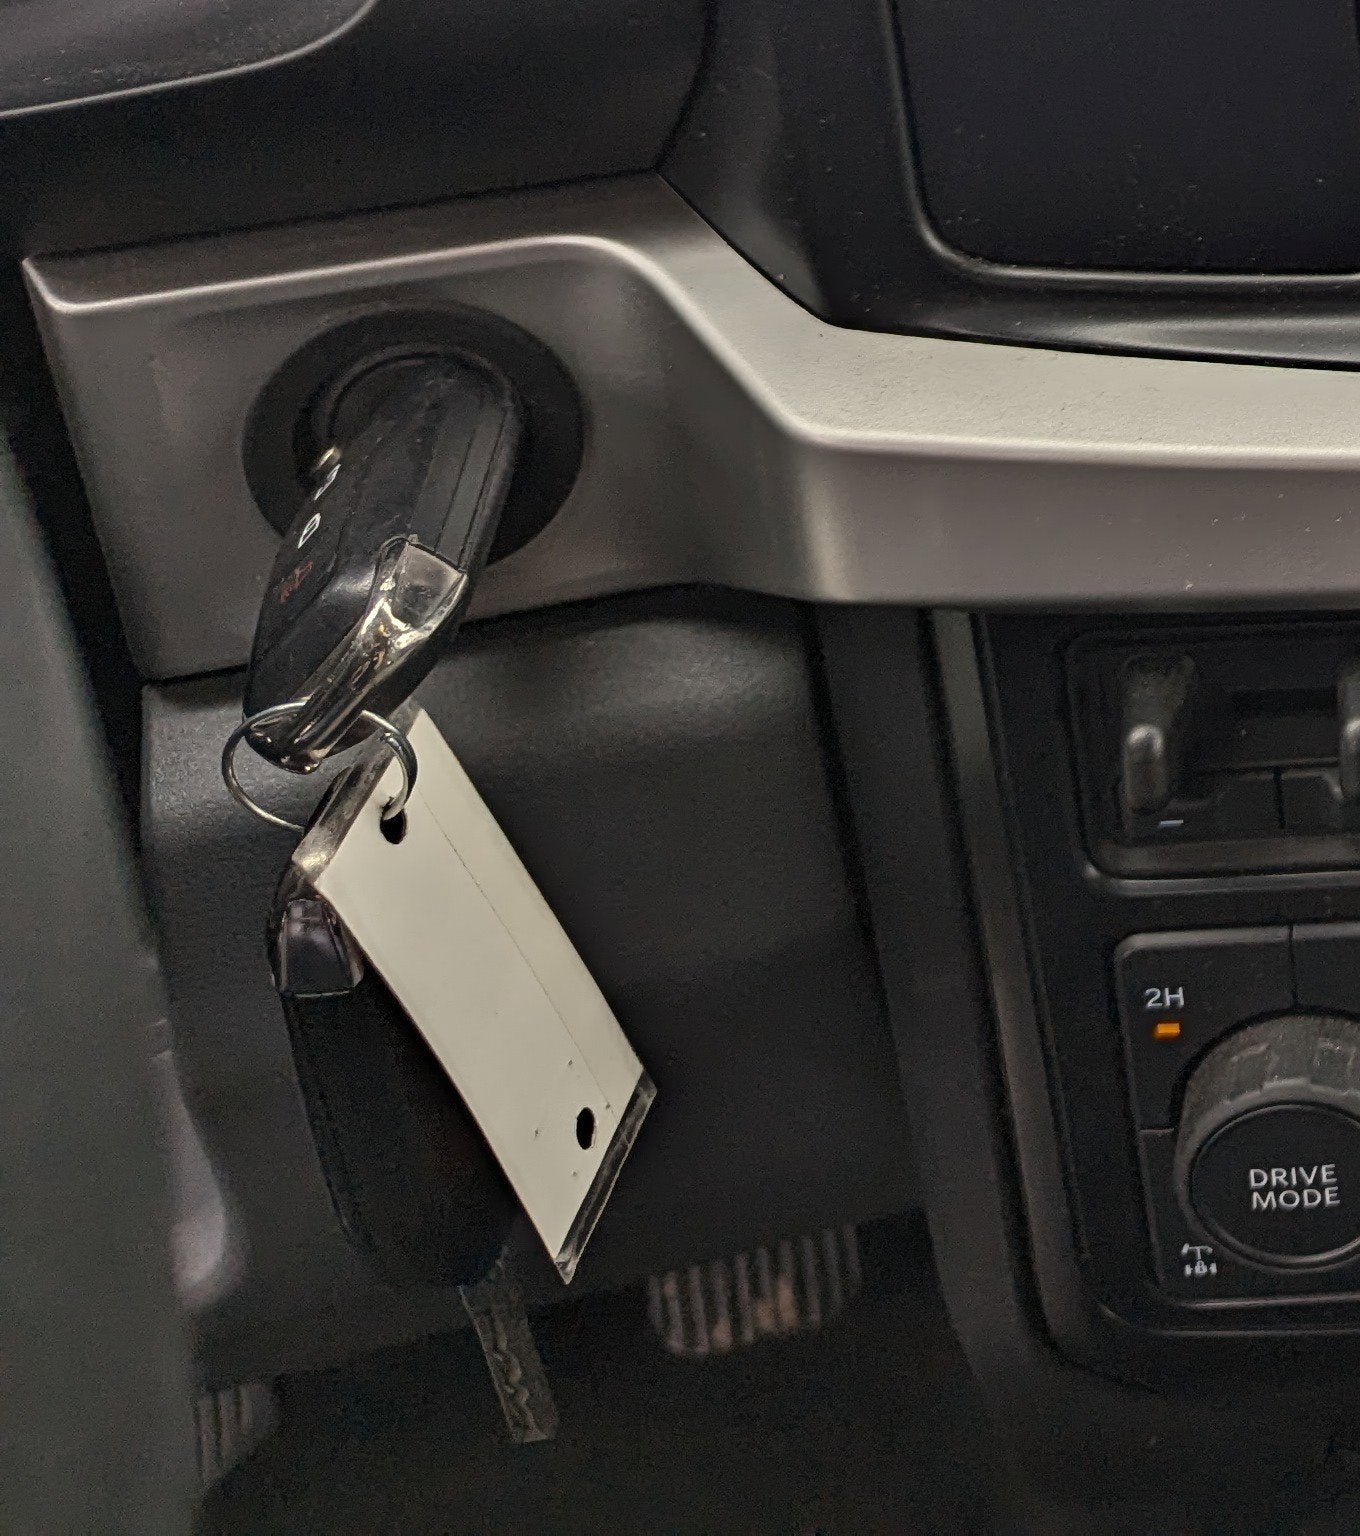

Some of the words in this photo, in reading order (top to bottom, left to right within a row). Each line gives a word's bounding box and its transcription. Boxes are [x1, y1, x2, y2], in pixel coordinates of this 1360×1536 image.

[1144, 986, 1185, 1010] 2H
[1249, 1163, 1338, 1189] DRIVE
[1252, 1186, 1341, 1211] MODE
